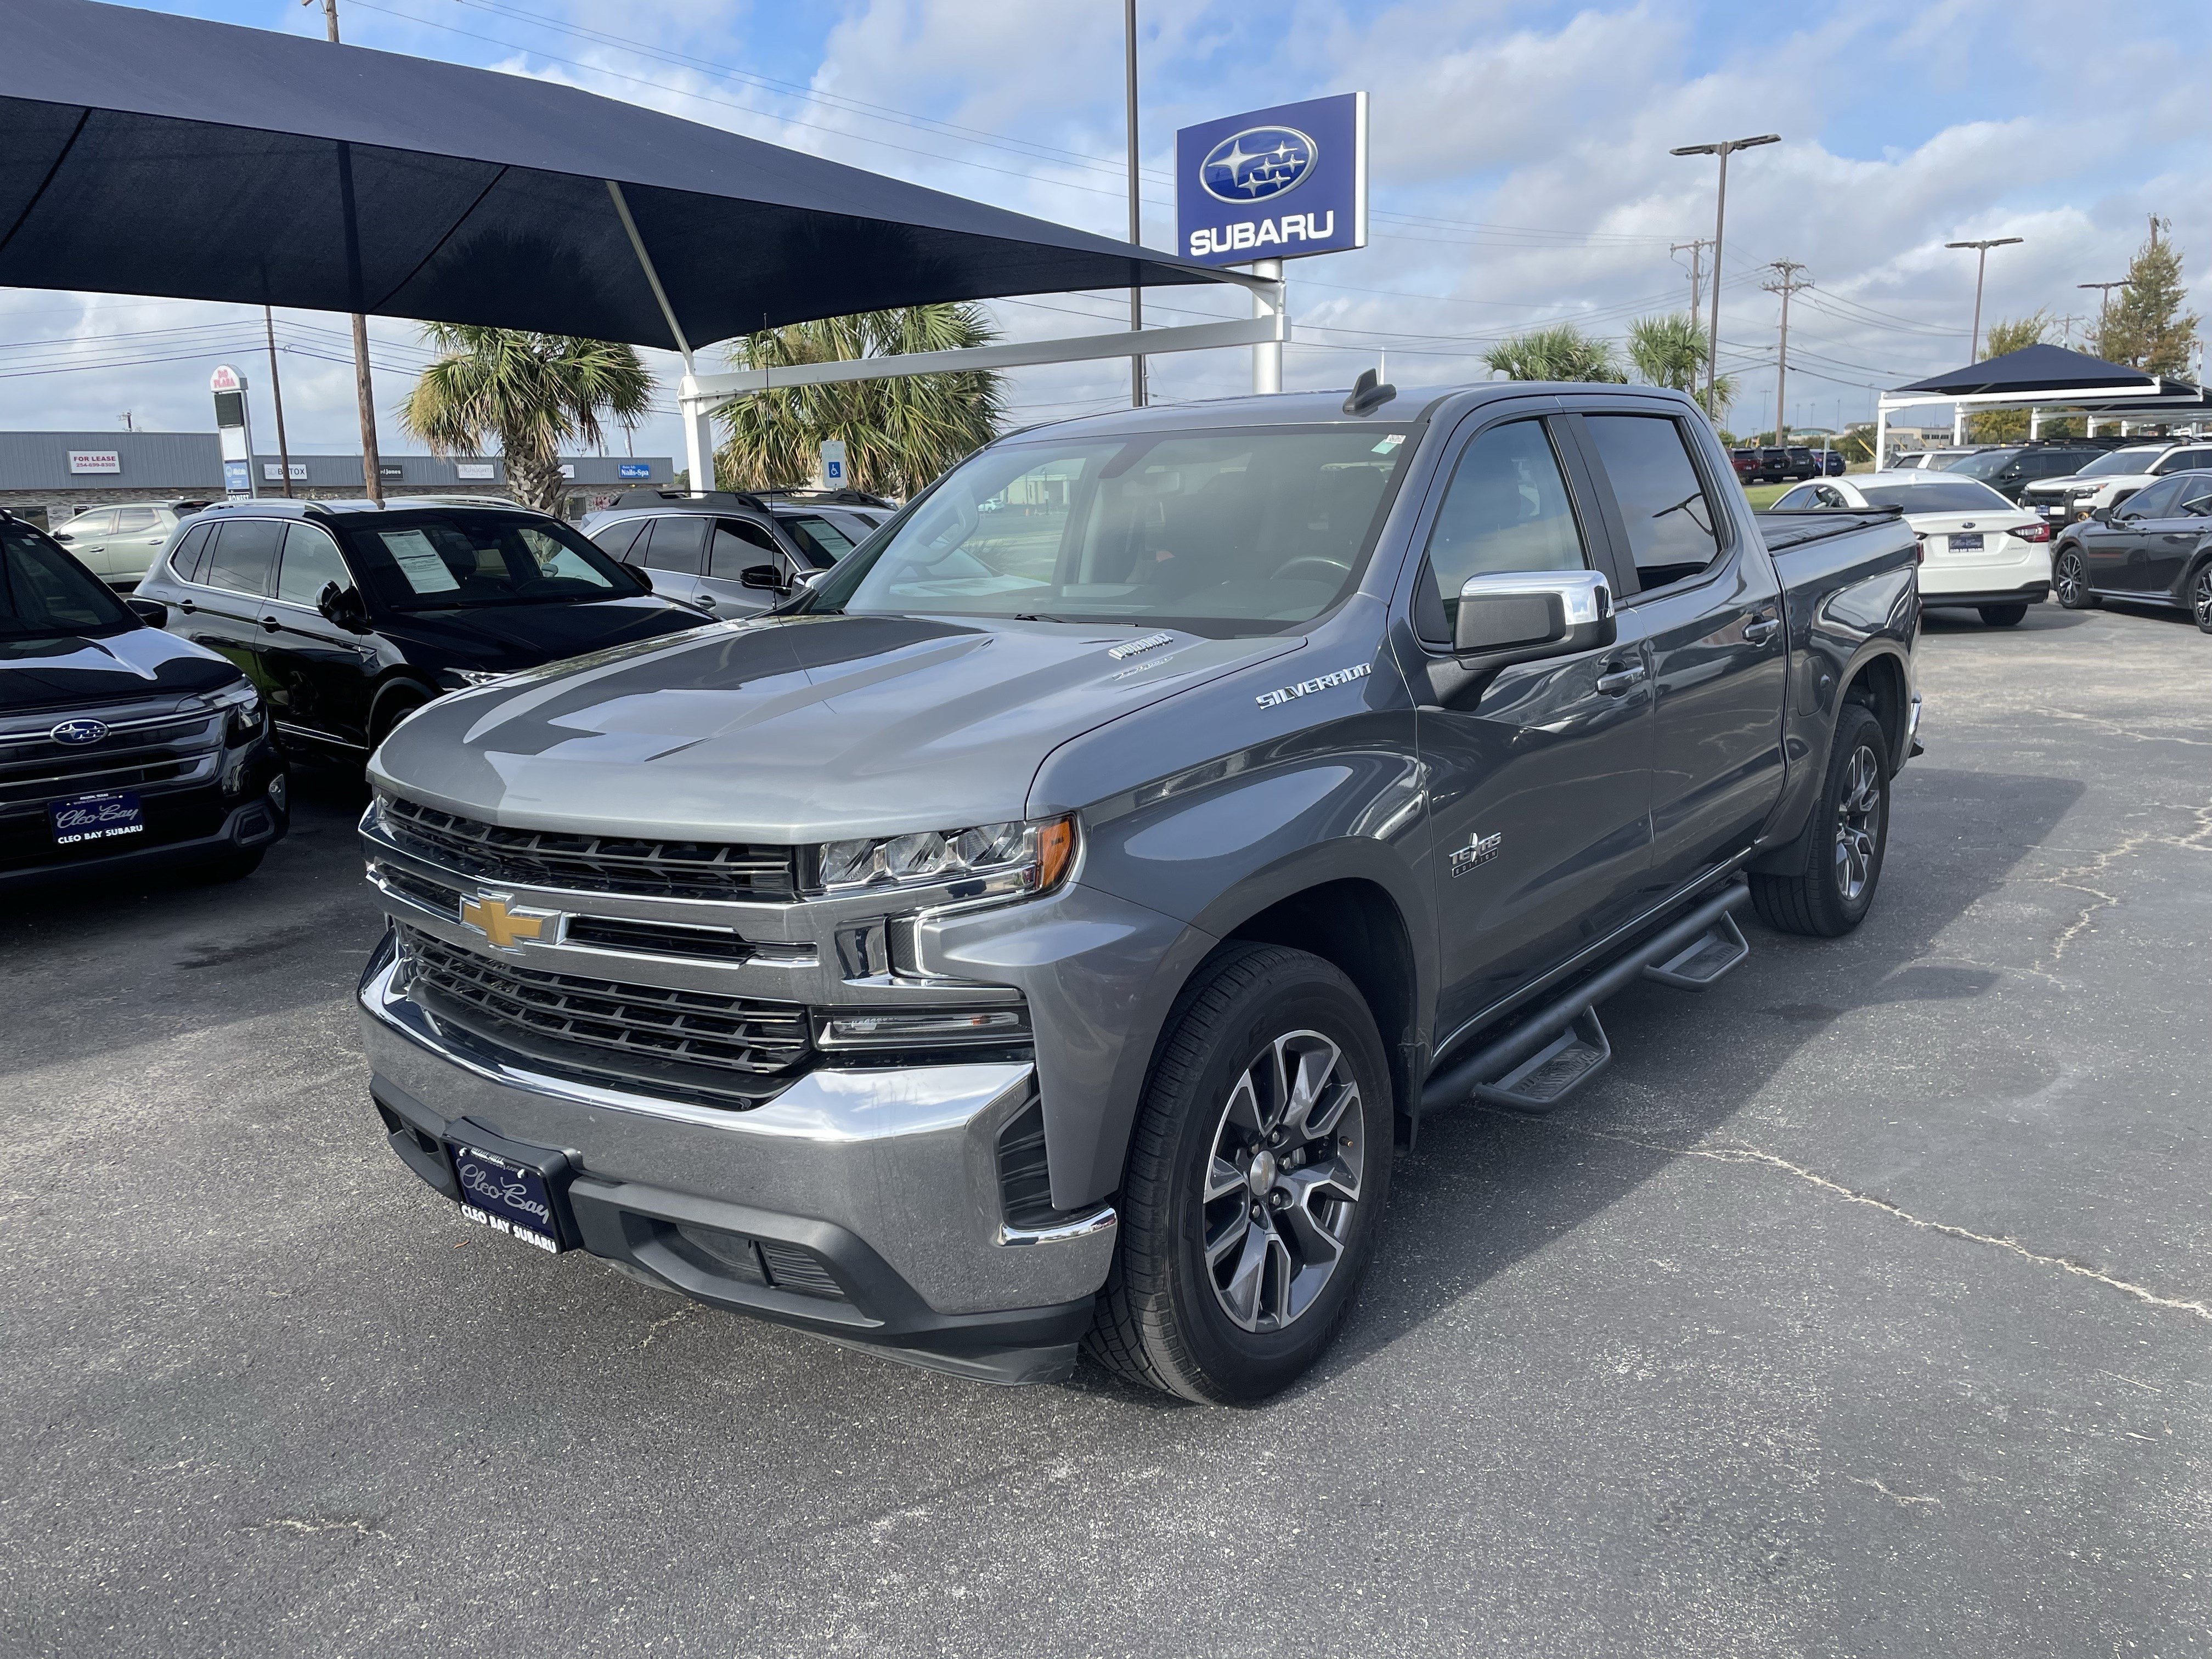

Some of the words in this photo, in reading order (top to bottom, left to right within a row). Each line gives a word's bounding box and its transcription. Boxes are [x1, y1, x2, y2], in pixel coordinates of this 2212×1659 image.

[1190, 211, 1334, 256] SUBARU
[1255, 662, 1372, 709] SILVERADO
[56, 810, 99, 828] Cleo
[99, 804, 139, 821] Bay
[58, 834, 82, 844] CLEO
[84, 831, 103, 840] BAY
[105, 825, 143, 837] SUBARU
[1455, 850, 1496, 874] EDITION
[456, 1158, 503, 1199] Cleo
[499, 1177, 550, 1224] Bay
[461, 1205, 488, 1224] CLEO
[489, 1215, 510, 1234] BAY
[512, 1225, 557, 1254] SUBARU
